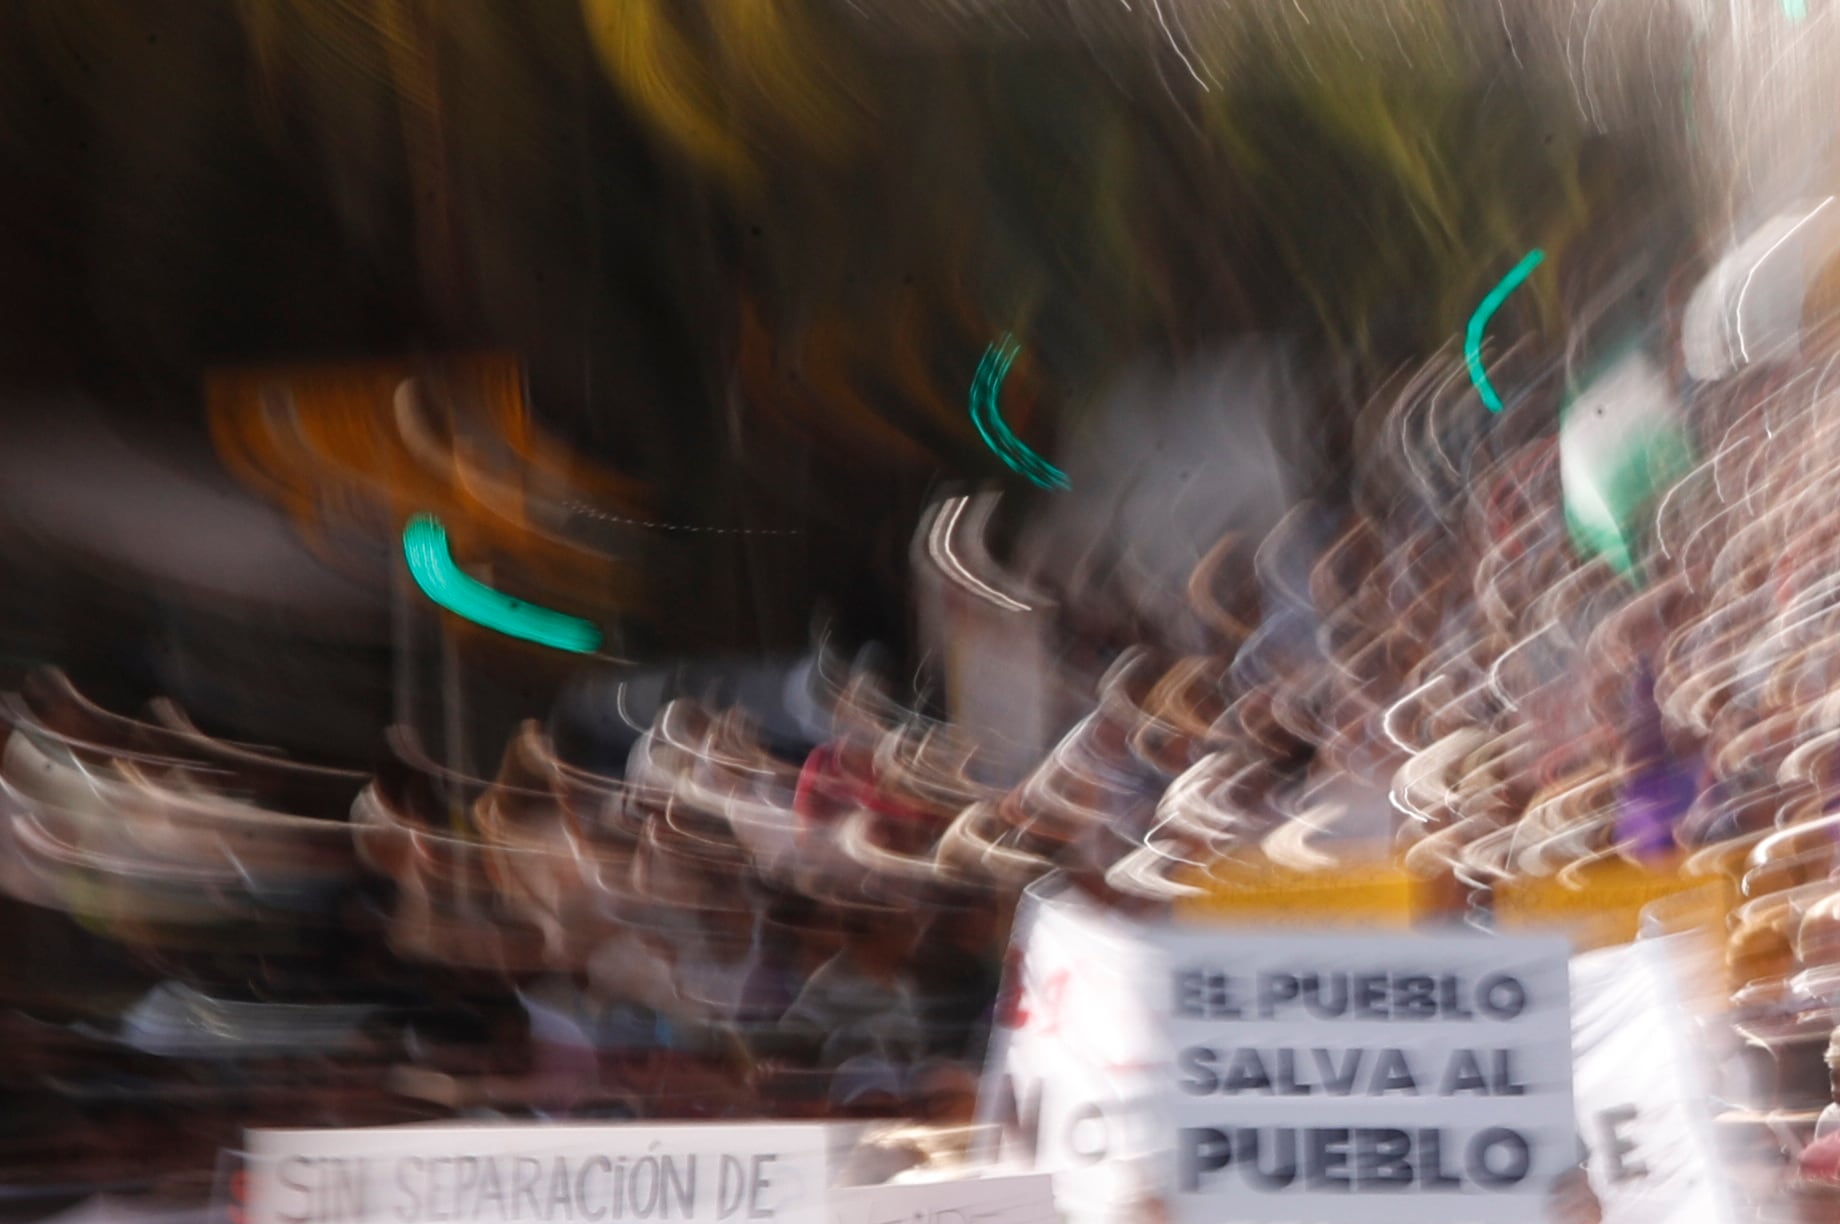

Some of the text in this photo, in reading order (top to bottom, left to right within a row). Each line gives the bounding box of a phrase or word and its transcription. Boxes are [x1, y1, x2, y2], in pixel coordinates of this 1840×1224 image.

[1172, 971, 1527, 1021] EL PUEBLO
[1177, 1047, 1526, 1097] SALVA AL
[716, 1152, 778, 1221] DE
[1176, 1126, 1531, 1194] PUEBLO
